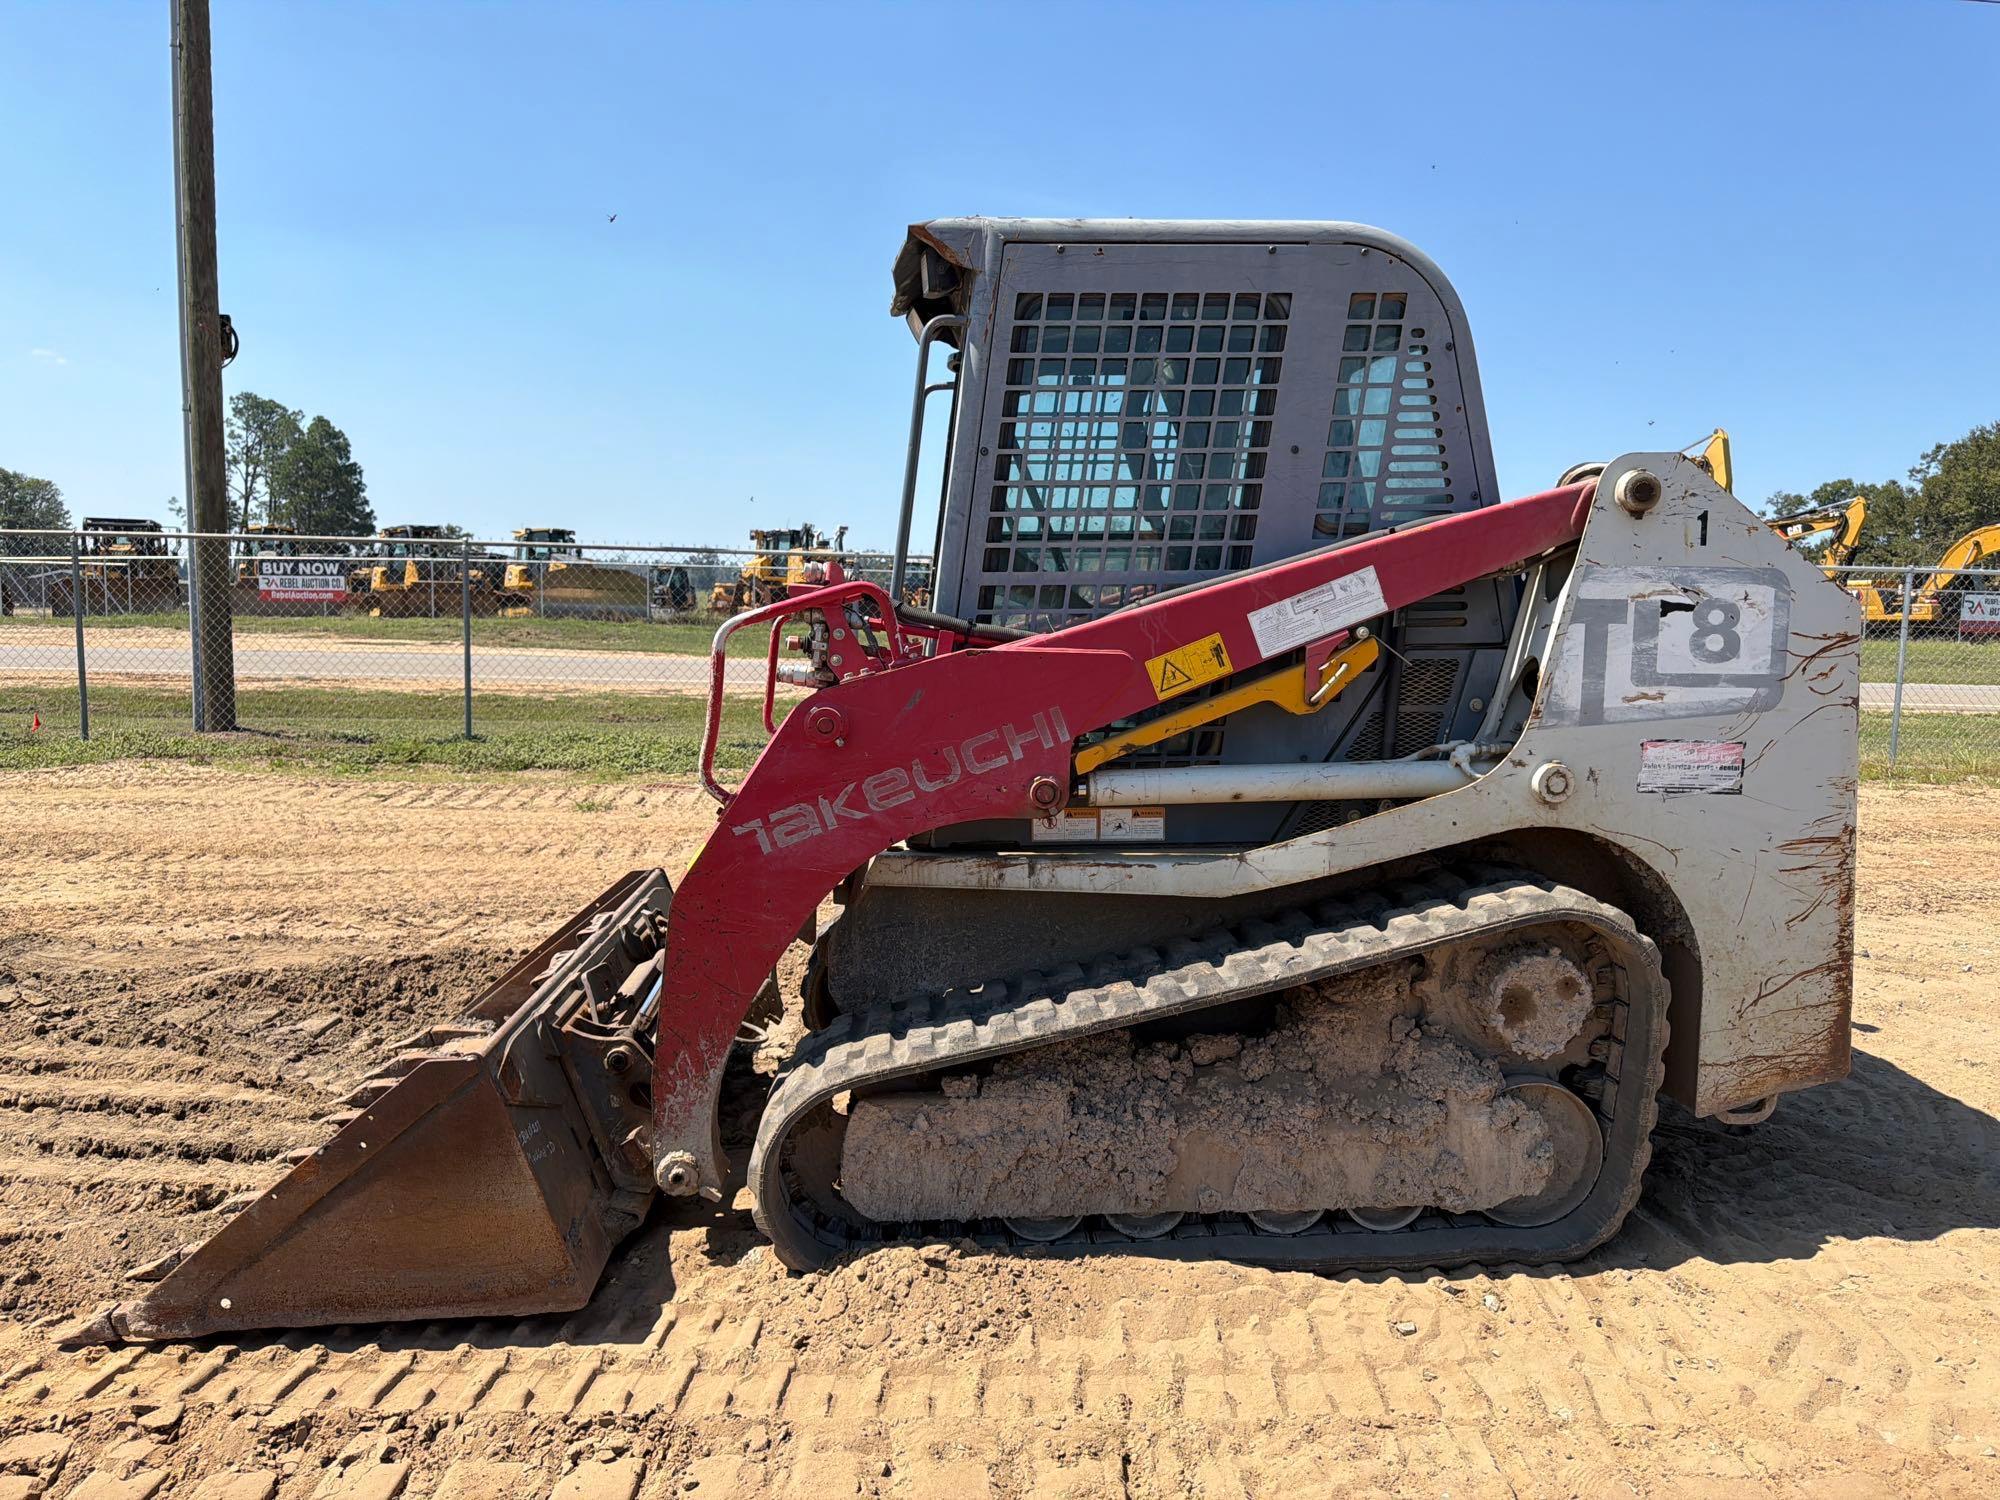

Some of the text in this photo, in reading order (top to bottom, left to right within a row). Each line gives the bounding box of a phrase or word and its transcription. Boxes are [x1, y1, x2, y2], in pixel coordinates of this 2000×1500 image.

[1696, 510, 1708, 546] 1
[1787, 524, 1802, 536] CAT
[262, 563, 339, 575] BUY NOW
[279, 578, 299, 588] REBEL
[301, 578, 330, 589] AUCTION
[331, 578, 343, 589] CO.
[271, 591, 334, 600] RebelAuction.com
[1667, 763, 1691, 771] Service
